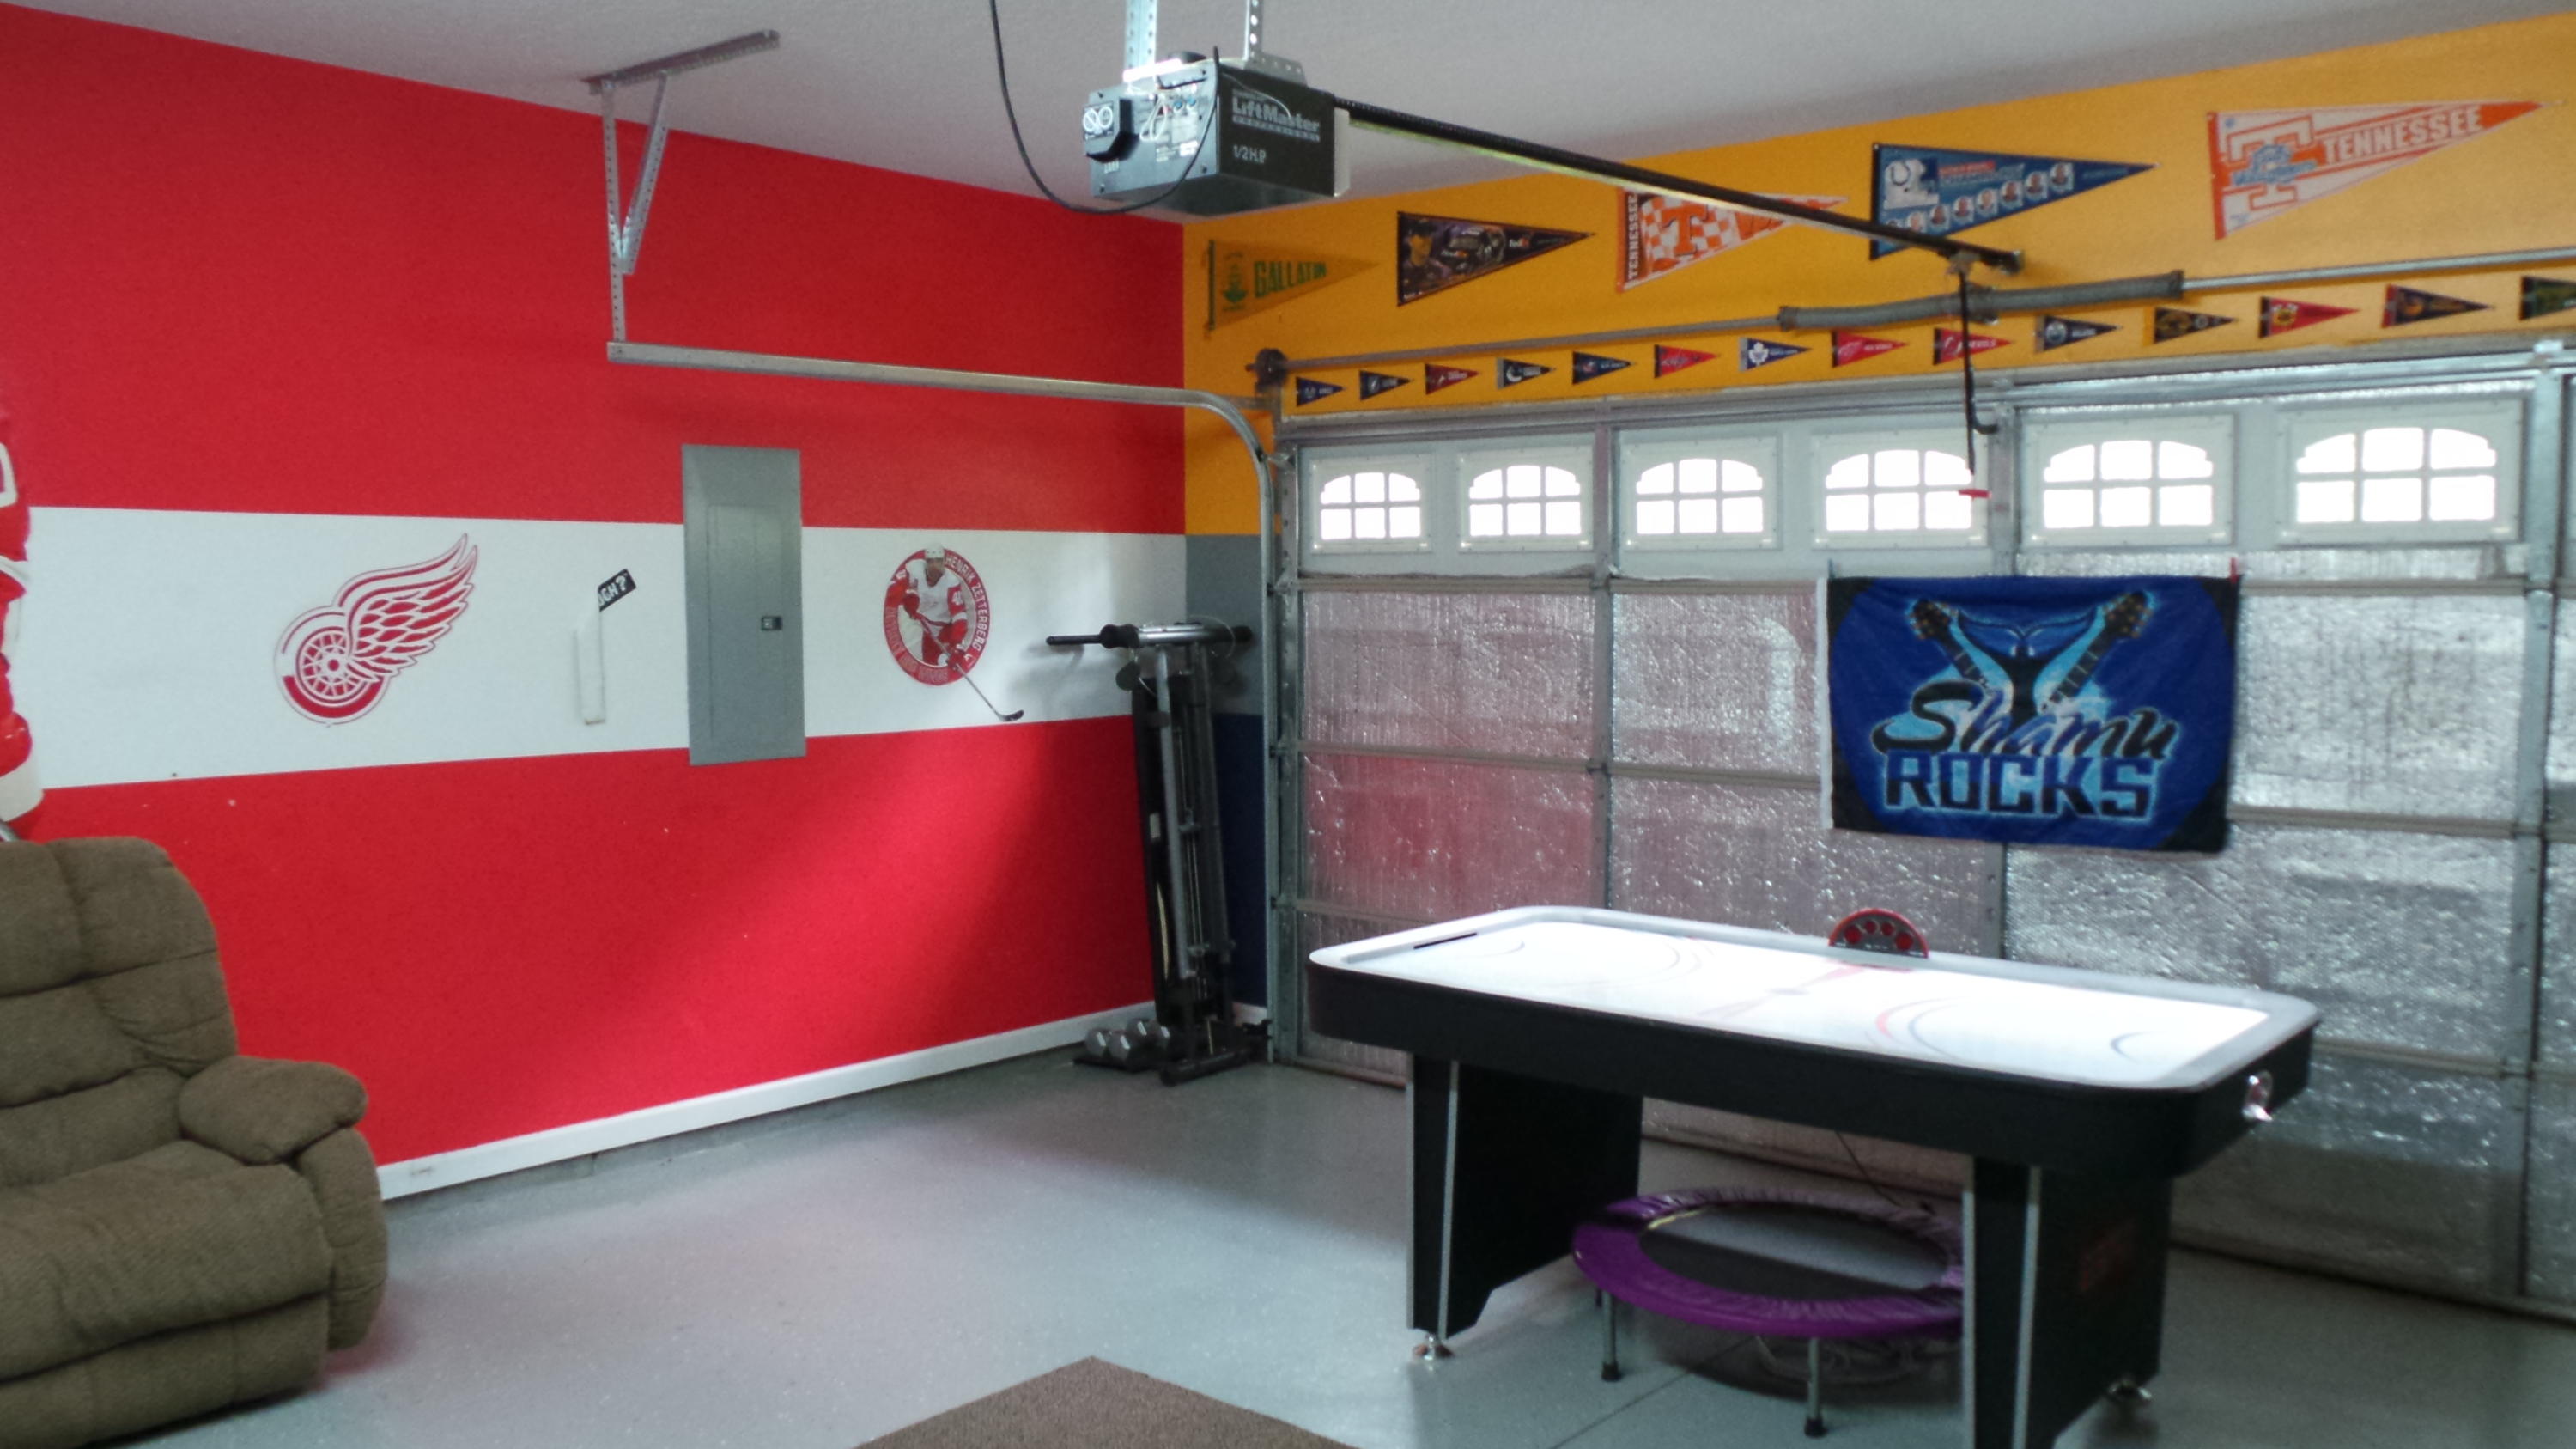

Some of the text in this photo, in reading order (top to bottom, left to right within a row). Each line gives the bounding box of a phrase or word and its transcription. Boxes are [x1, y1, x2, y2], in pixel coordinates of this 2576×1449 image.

[2324, 104, 2481, 165] TENNESSEE
[1627, 193, 1638, 280] TENNESSEE
[945, 555, 989, 652] HENRIK ZETTERBERG
[1871, 679, 2180, 760] Shamu
[1886, 749, 2156, 819] ROCKS
